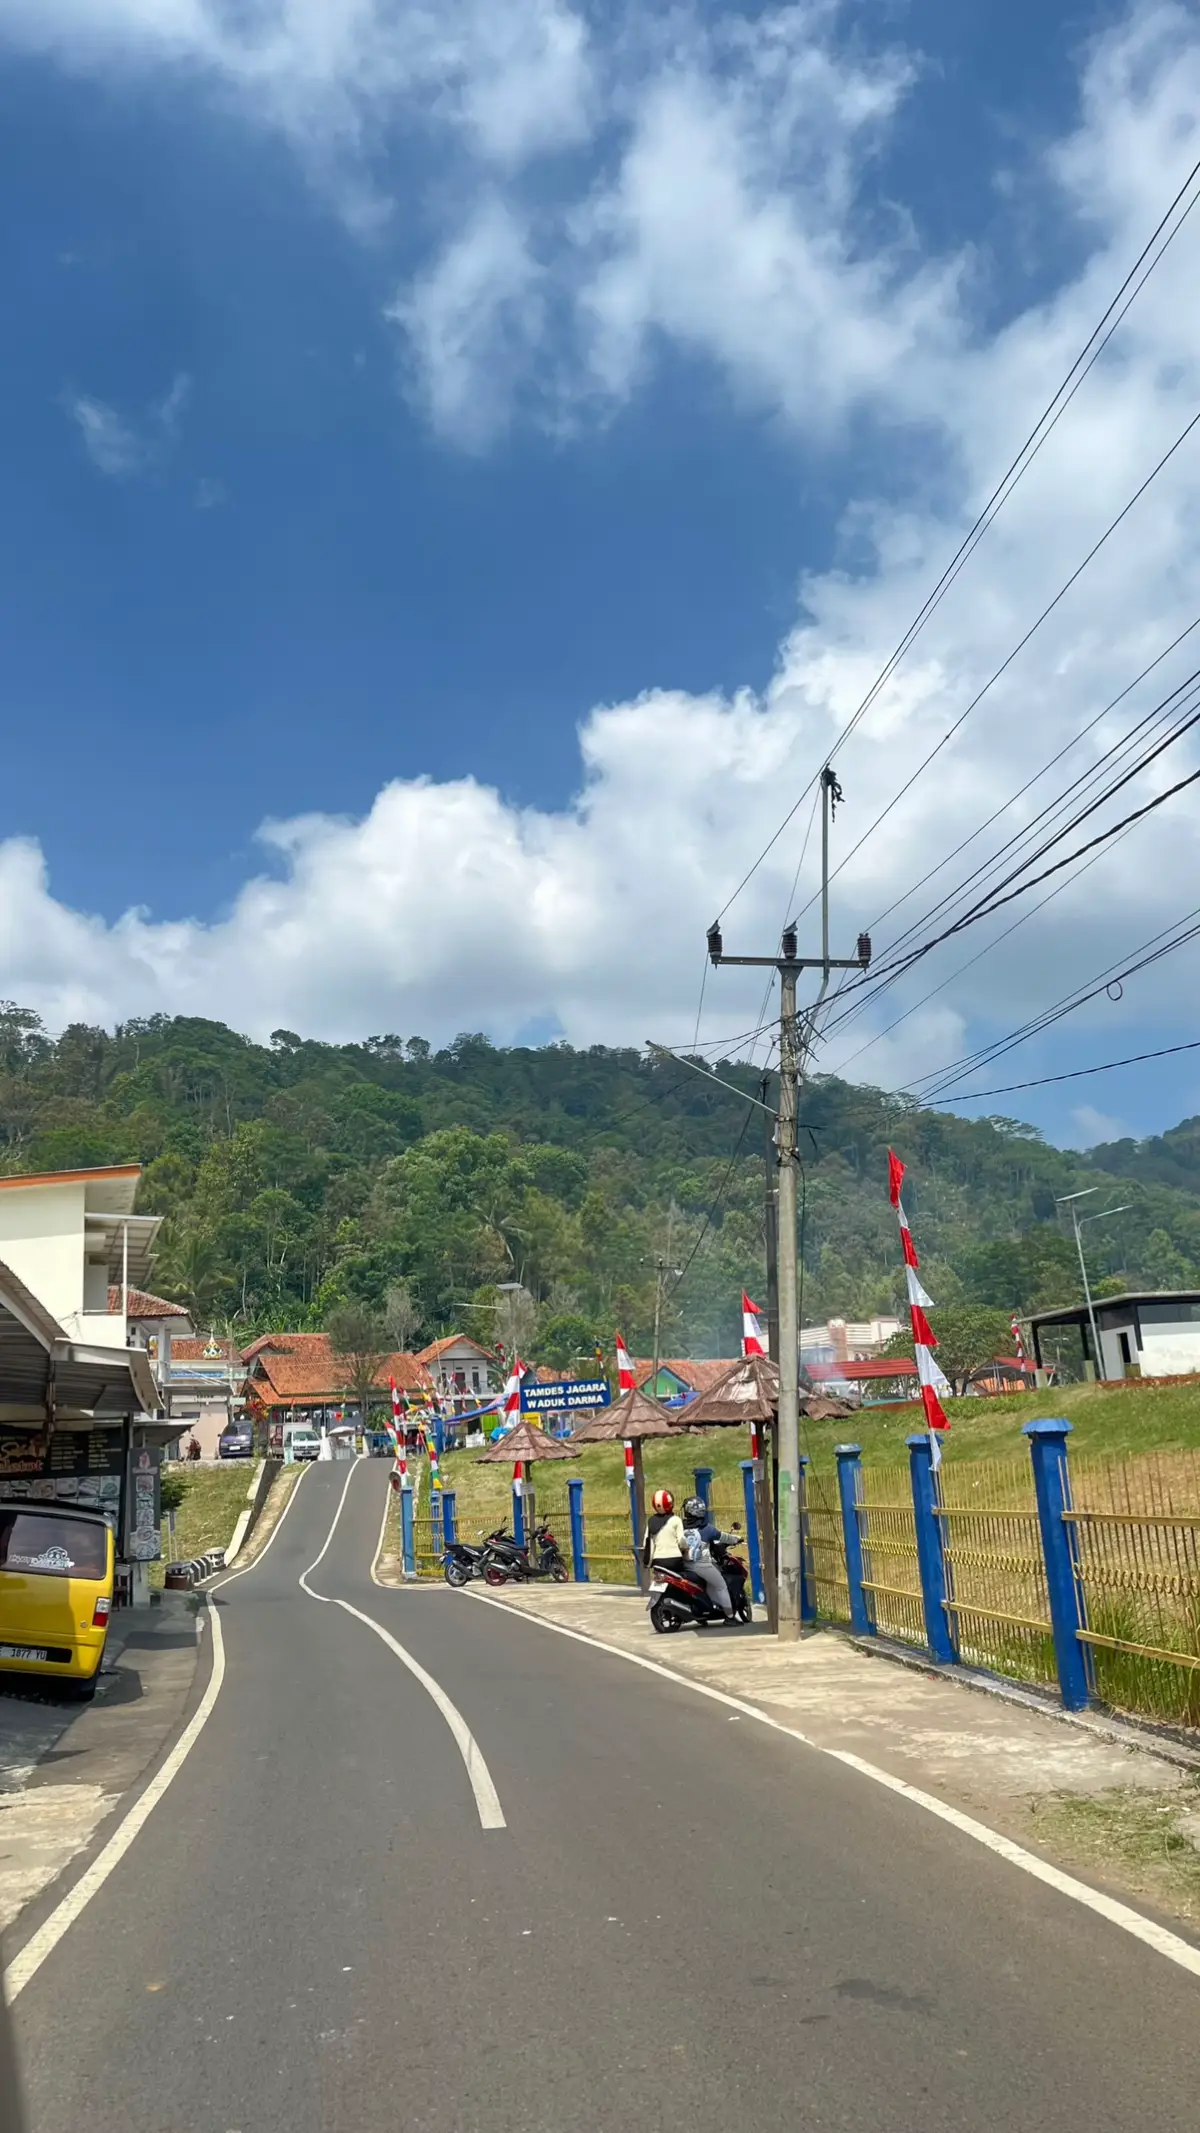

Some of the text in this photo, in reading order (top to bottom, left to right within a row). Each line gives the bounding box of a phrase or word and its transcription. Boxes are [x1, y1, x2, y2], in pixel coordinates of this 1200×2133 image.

[523, 1383, 606, 1397] TAMDES JAGARA
[527, 1395, 603, 1409] WADUK DARMA
